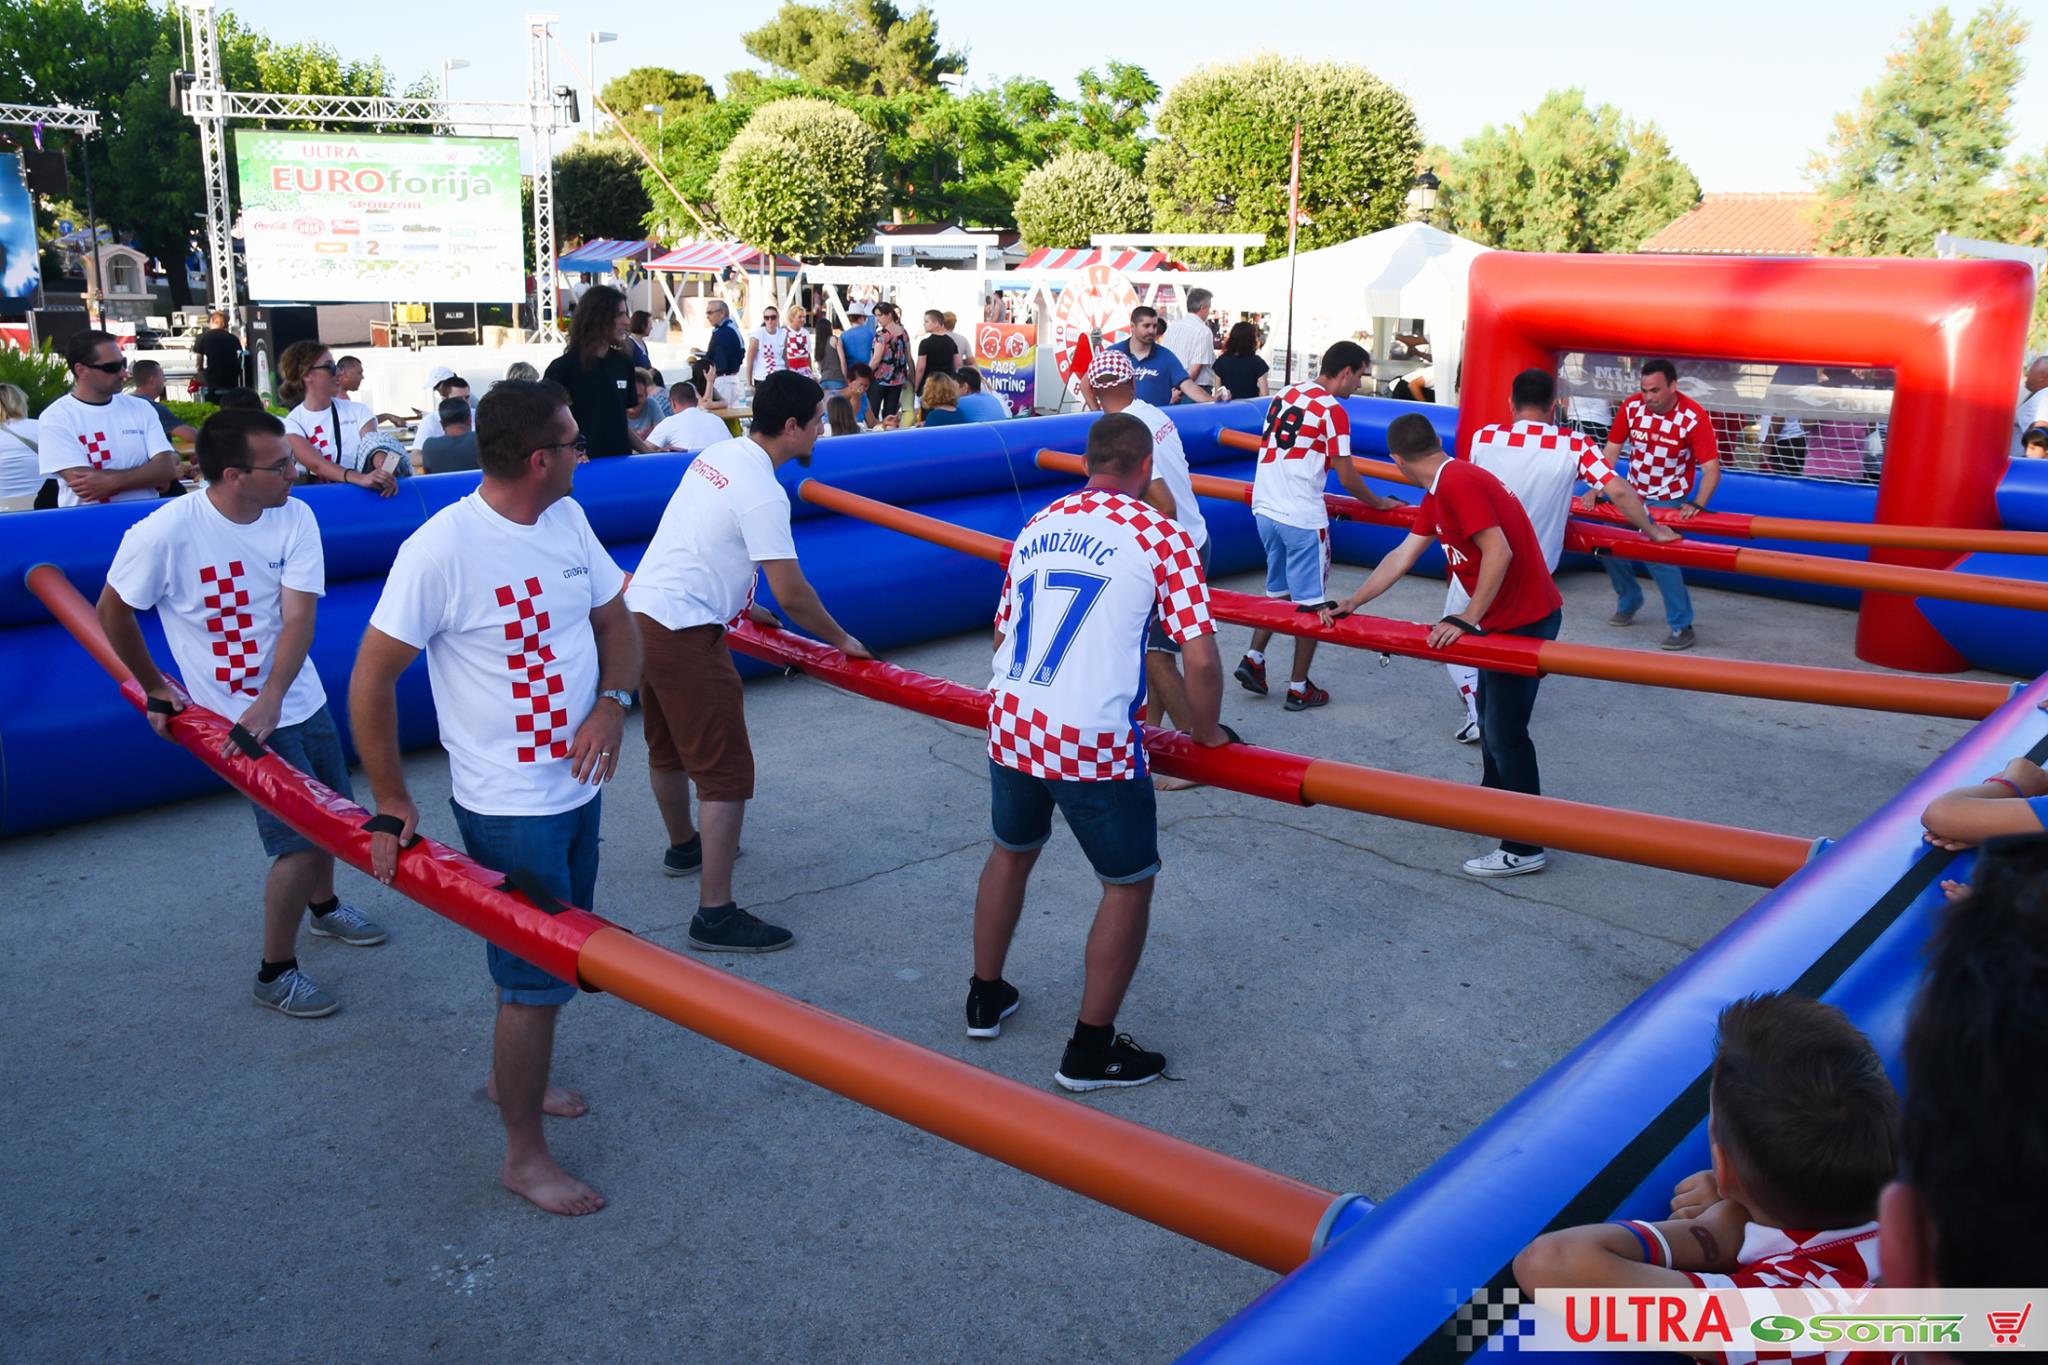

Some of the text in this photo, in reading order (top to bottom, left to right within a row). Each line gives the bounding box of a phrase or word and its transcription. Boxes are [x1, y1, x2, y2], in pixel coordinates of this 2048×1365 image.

[302, 145, 359, 159] ULTRA
[272, 167, 492, 201] EUROforija
[348, 201, 422, 210] SPONZORI
[367, 240, 380, 256] 2
[990, 360, 1017, 375] FACE
[1262, 395, 1306, 451] 98
[690, 457, 730, 490] RVATSKA
[1019, 528, 1119, 567] MANDŽUKIĆ
[1006, 568, 1113, 688] 17
